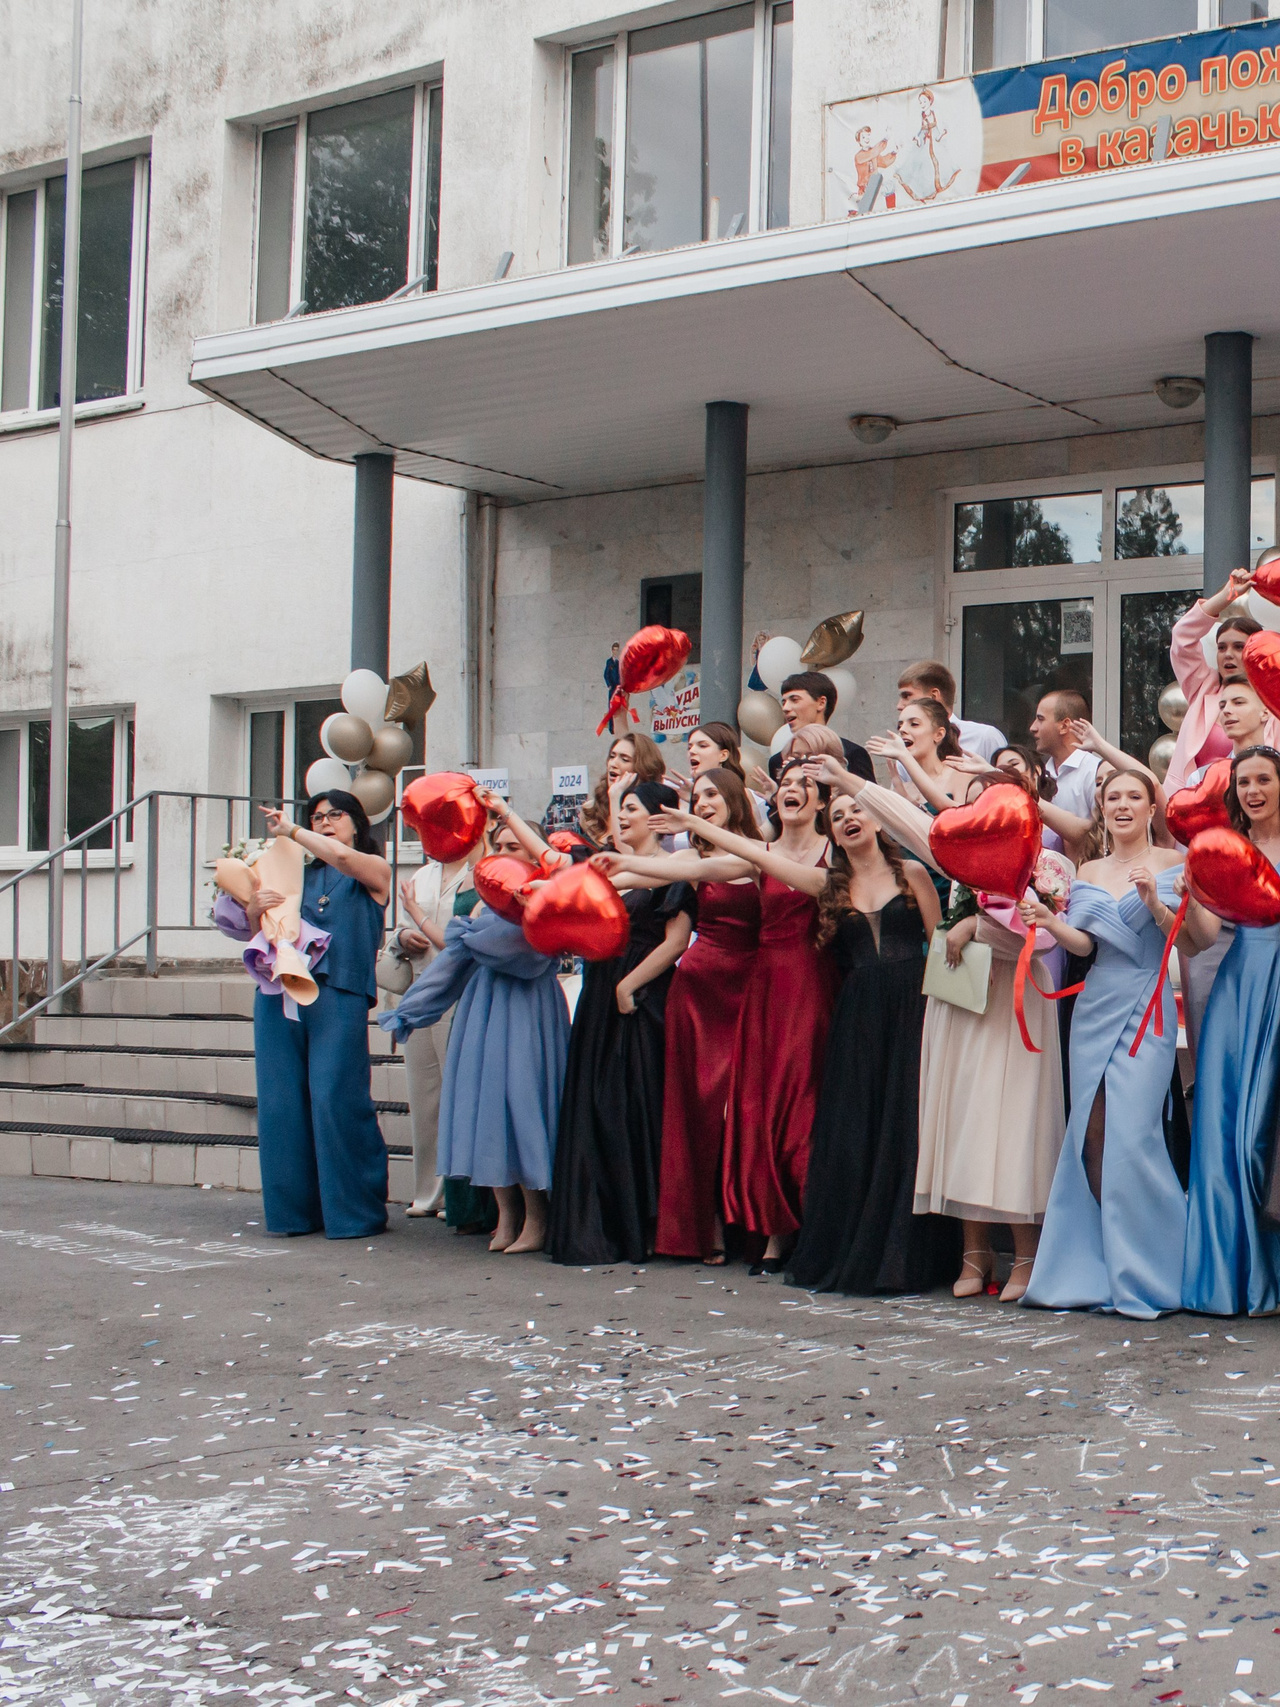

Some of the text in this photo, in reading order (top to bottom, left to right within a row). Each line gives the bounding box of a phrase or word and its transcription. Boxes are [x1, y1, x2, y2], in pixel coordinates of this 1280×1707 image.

[1033, 58, 1188, 136] Добро
[1059, 136, 1086, 175] в
[559, 774, 582, 788] 2024
